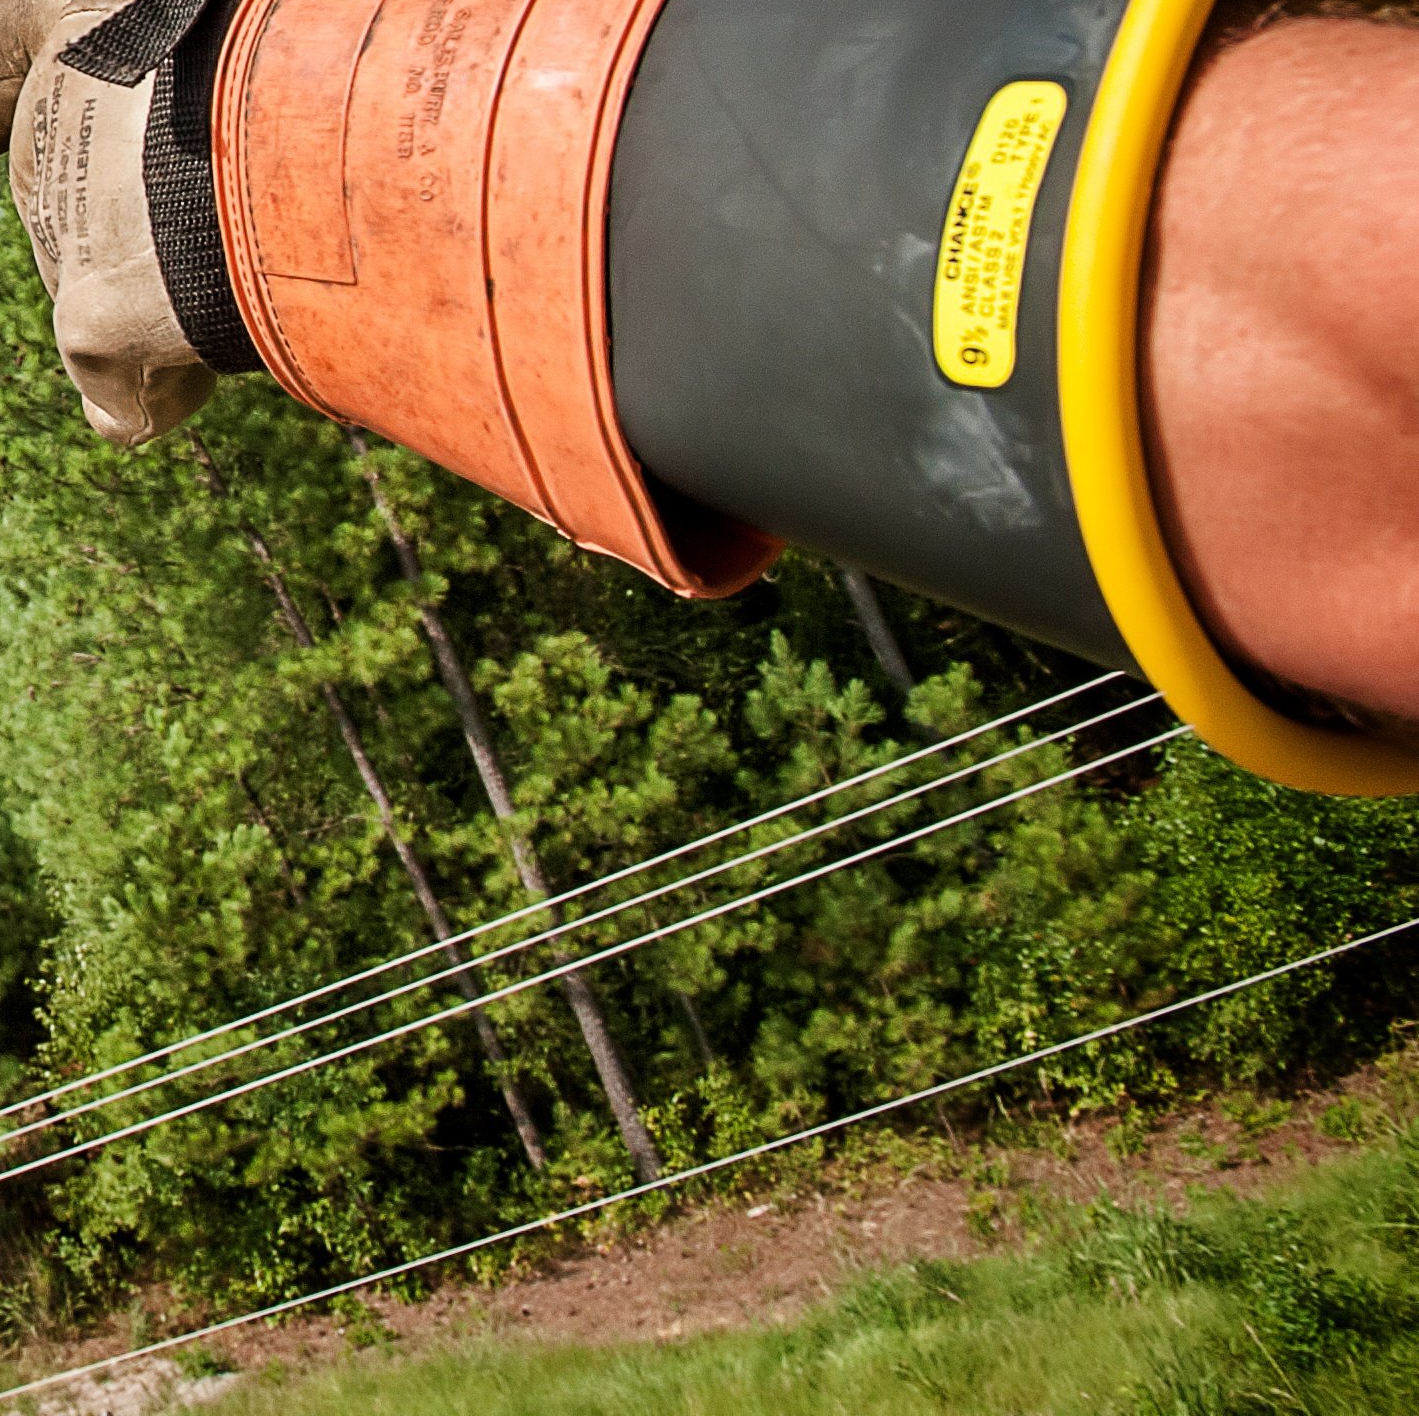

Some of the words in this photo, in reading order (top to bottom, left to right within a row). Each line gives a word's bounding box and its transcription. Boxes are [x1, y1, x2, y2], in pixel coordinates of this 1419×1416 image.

[42, 72, 65, 211] PROTECTORS
[76, 97, 97, 182] LENGTH
[991, 118, 1020, 164] D120
[1009, 112, 1040, 162] TYPE
[76, 187, 89, 239] INCH
[988, 229, 1006, 241] 2
[979, 246, 1003, 318] CLASS
